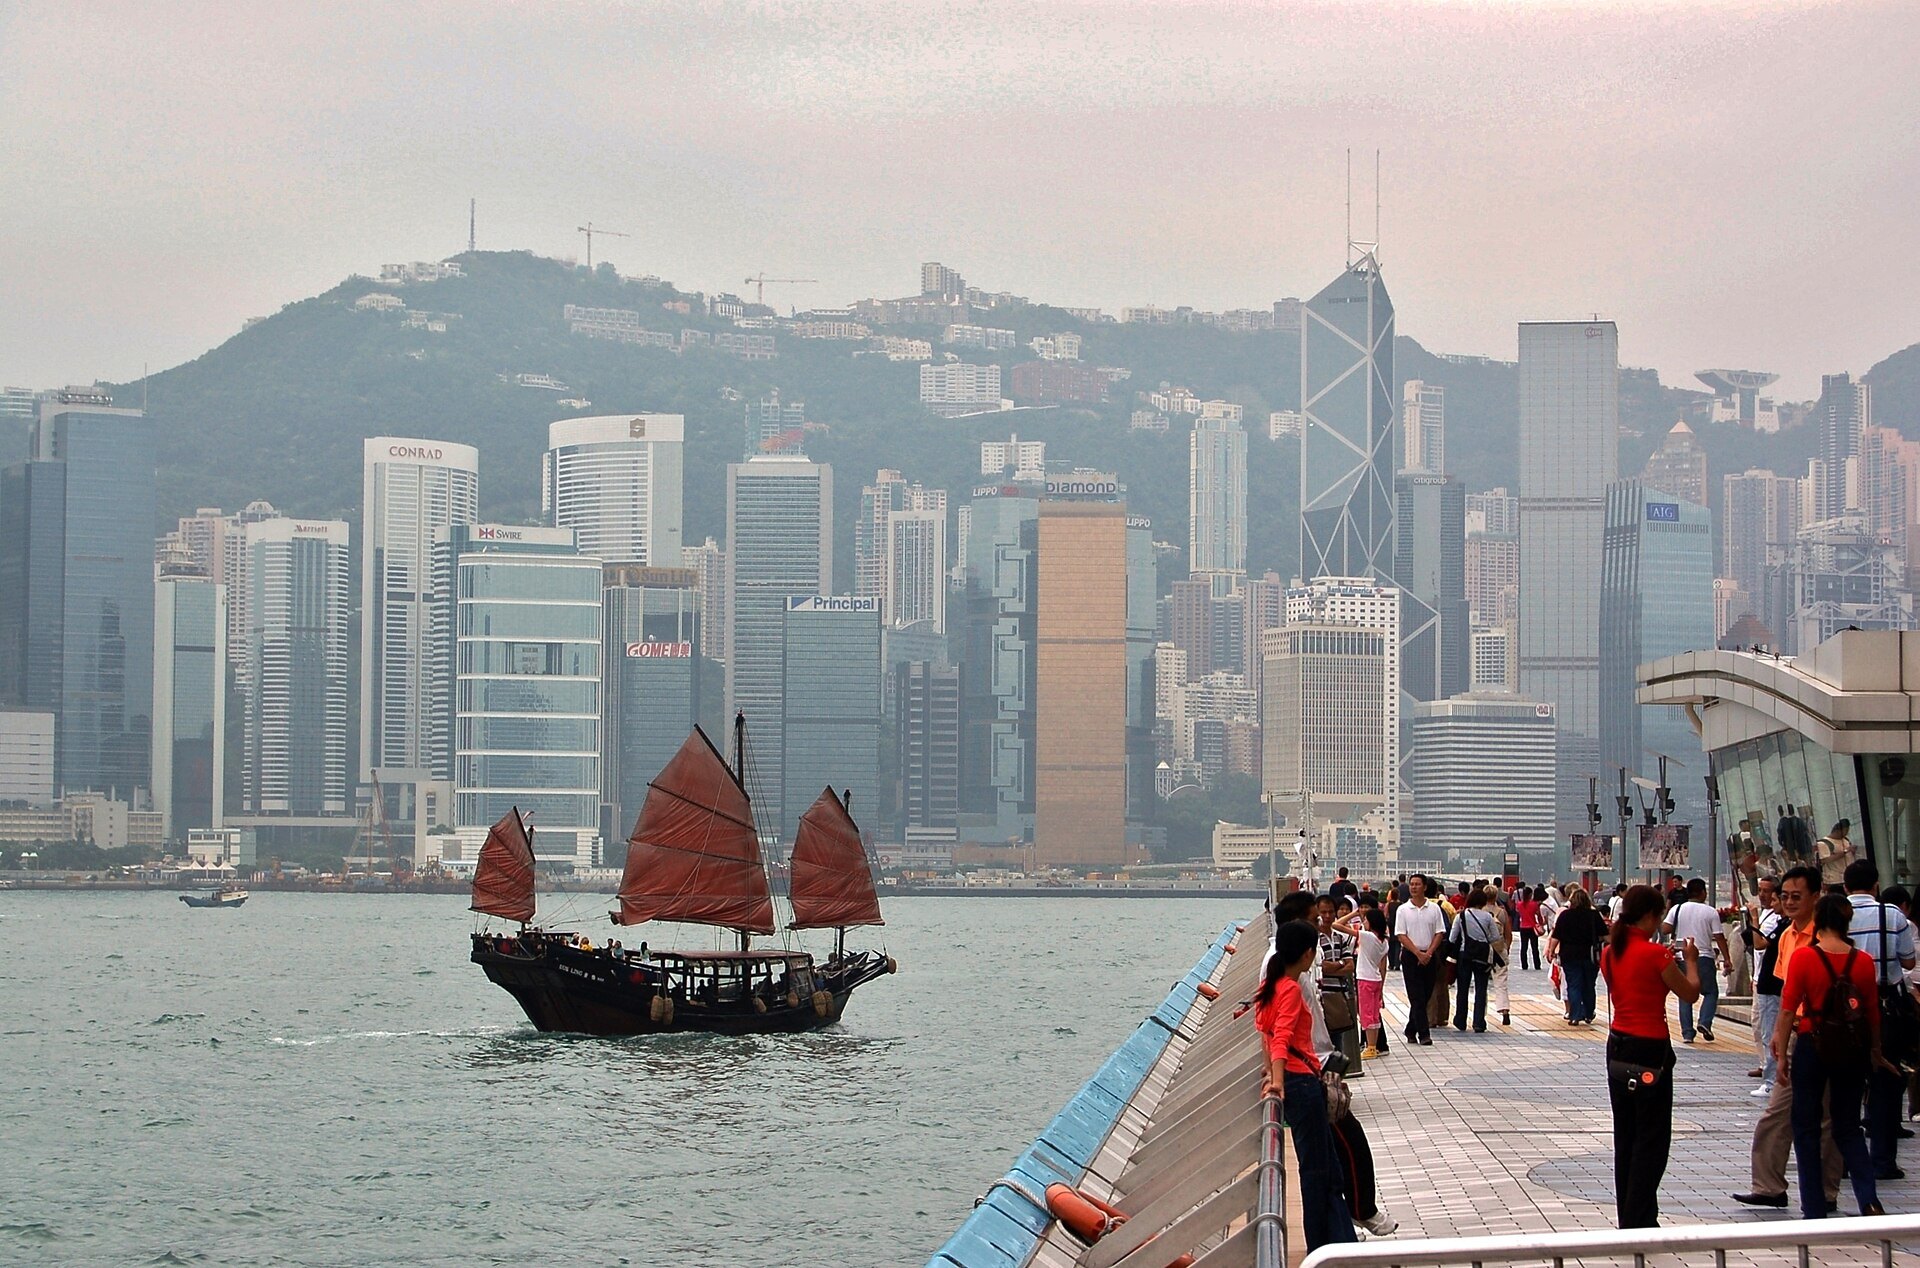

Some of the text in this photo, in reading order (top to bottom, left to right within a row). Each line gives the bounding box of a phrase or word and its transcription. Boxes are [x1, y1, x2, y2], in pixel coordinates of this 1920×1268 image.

[389, 446, 443, 459] CONRAD
[973, 486, 998, 497] LIPPO
[1653, 507, 1673, 519] AIG
[294, 524, 328, 533] Marriott
[1126, 517, 1151, 528] LIPPO
[813, 597, 874, 612] Principal
[627, 643, 670, 657] GOME
